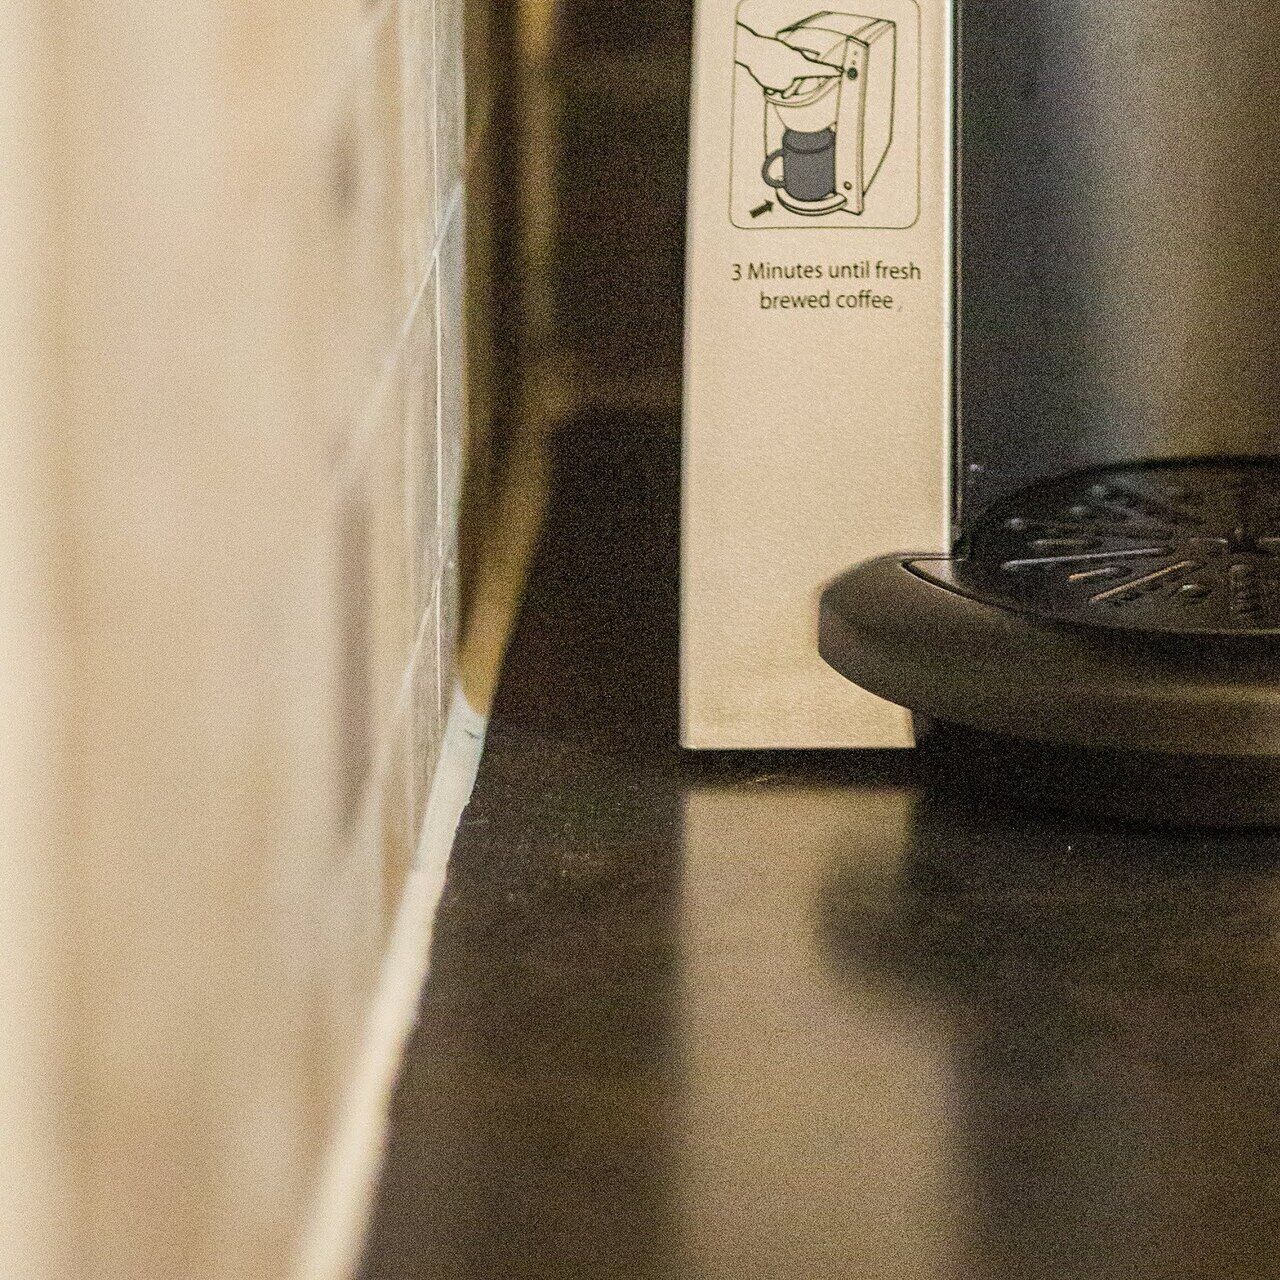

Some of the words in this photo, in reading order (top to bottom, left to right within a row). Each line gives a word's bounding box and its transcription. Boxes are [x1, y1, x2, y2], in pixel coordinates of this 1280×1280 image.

[731, 263, 743, 282] 3
[747, 262, 824, 280] Minutes
[828, 260, 871, 280] until
[875, 260, 922, 280] fresh
[759, 290, 831, 310] brewed
[835, 289, 894, 309] coffee
